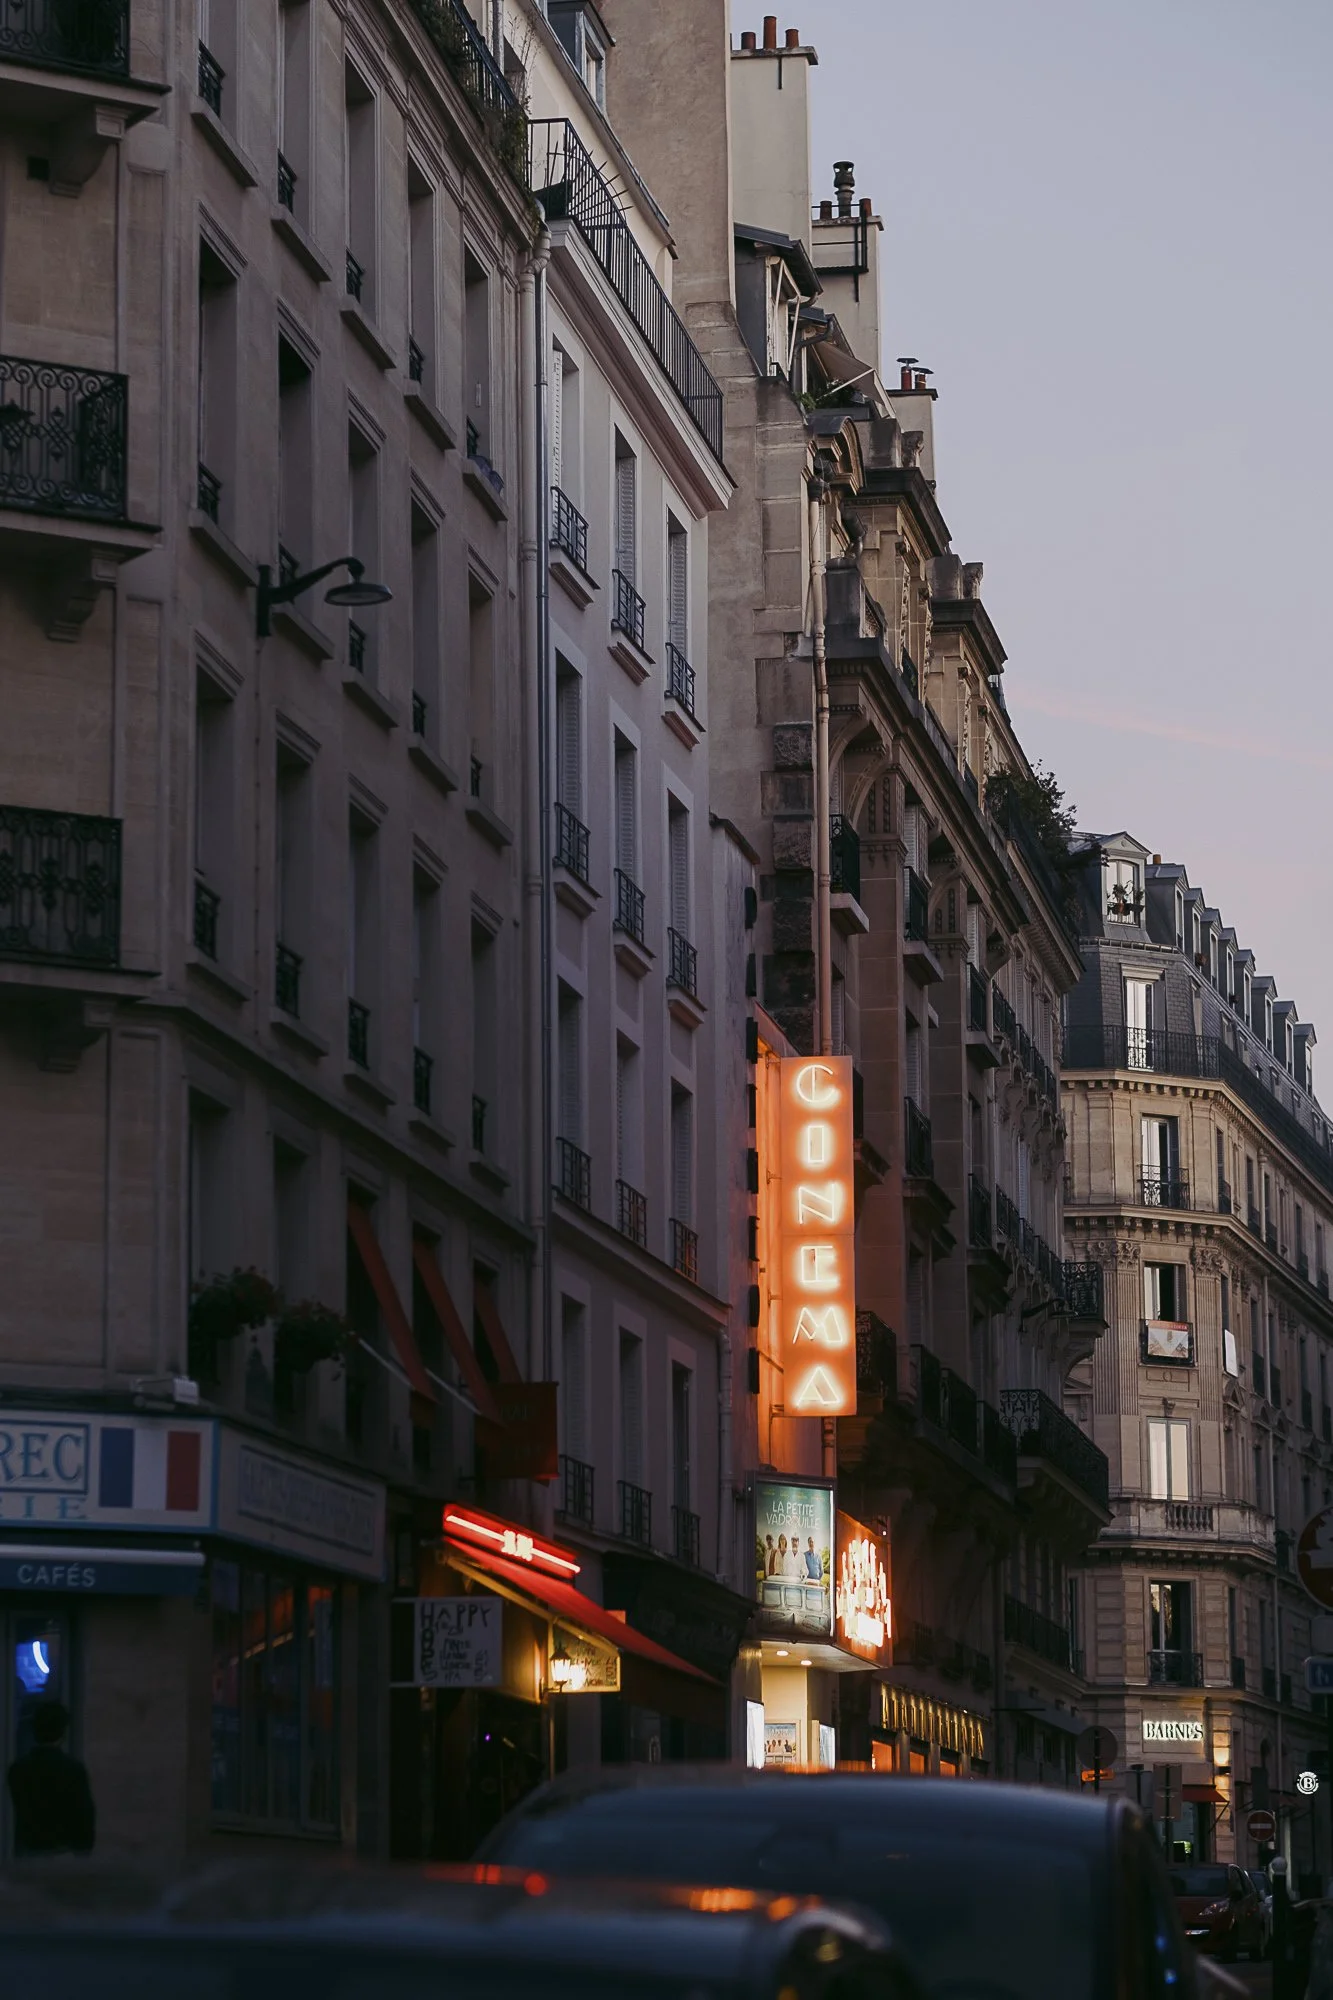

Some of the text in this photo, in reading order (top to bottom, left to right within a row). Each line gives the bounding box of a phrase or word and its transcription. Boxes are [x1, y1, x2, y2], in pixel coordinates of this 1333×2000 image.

[792, 1062, 845, 1408] CINEMA
[772, 1500, 815, 1517] LA PETITE
[766, 1512, 821, 1530] VADROUILLE
[17, 1563, 97, 1588] CAFÉS
[420, 1601, 492, 1628] HAPPY
[1145, 1721, 1205, 1740] BARNES
